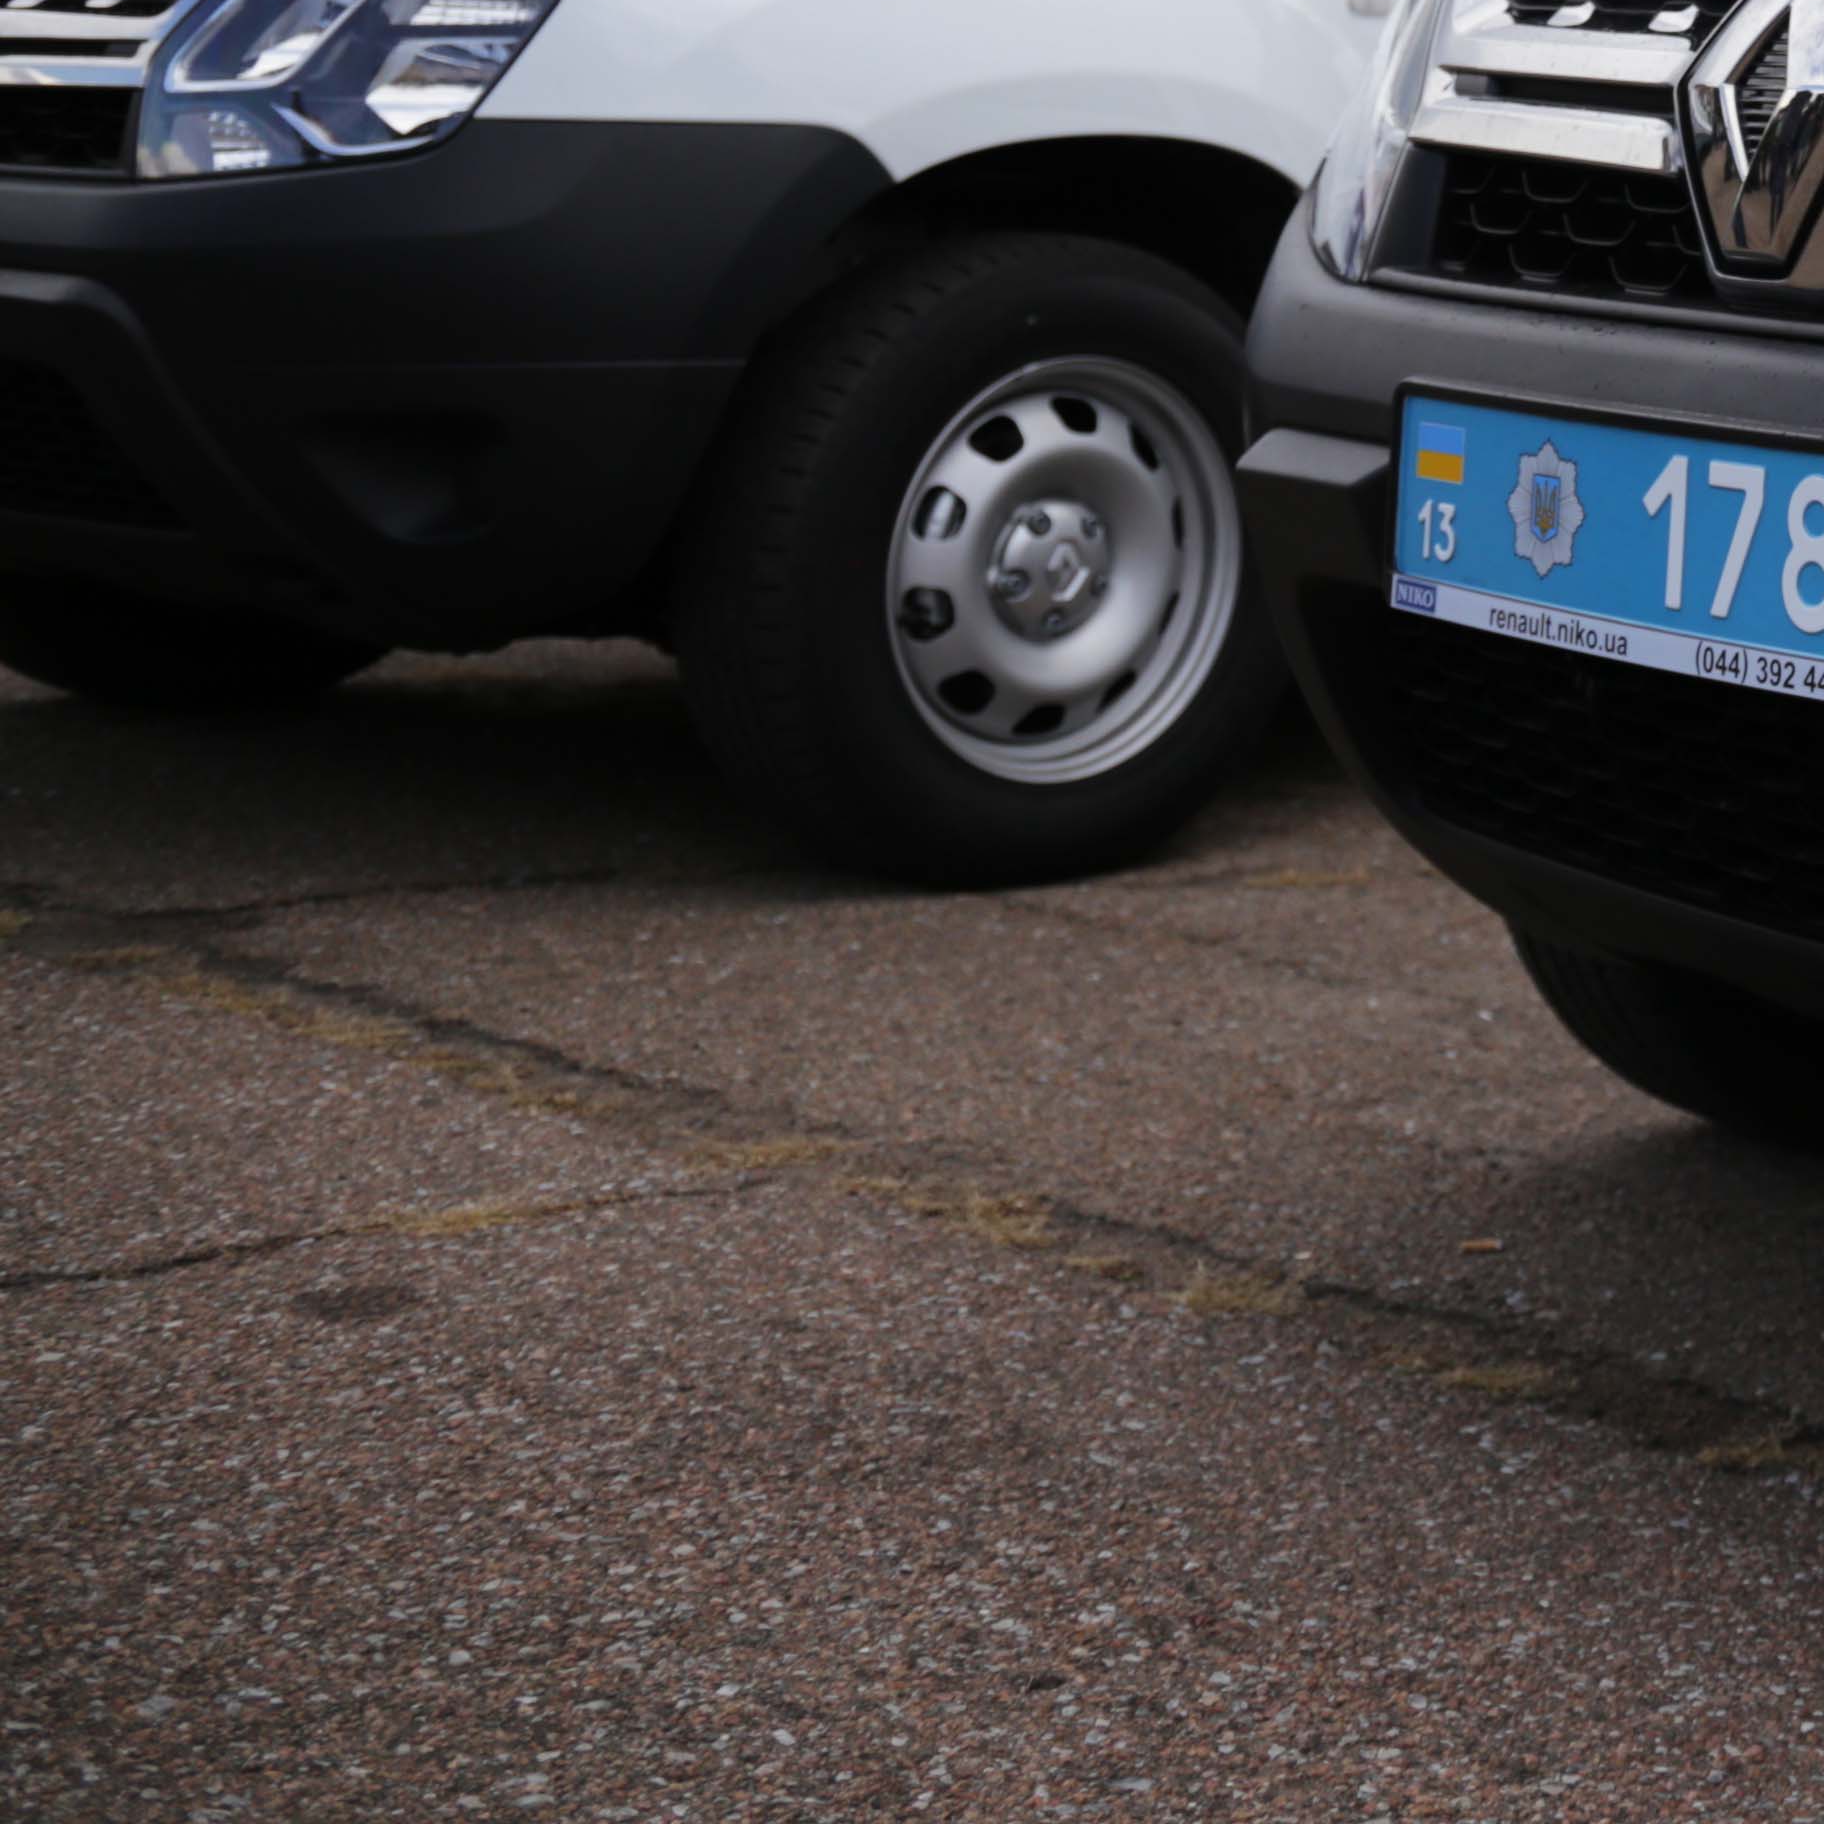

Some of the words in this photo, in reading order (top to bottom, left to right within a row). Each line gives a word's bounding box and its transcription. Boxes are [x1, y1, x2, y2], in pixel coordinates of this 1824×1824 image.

[1417, 498, 1457, 563] 13
[1396, 581, 1435, 610] NIKO
[1489, 606, 1628, 656] renault.niko.ua
[1695, 640, 1749, 683] (044)
[1756, 656, 1795, 689] 392
